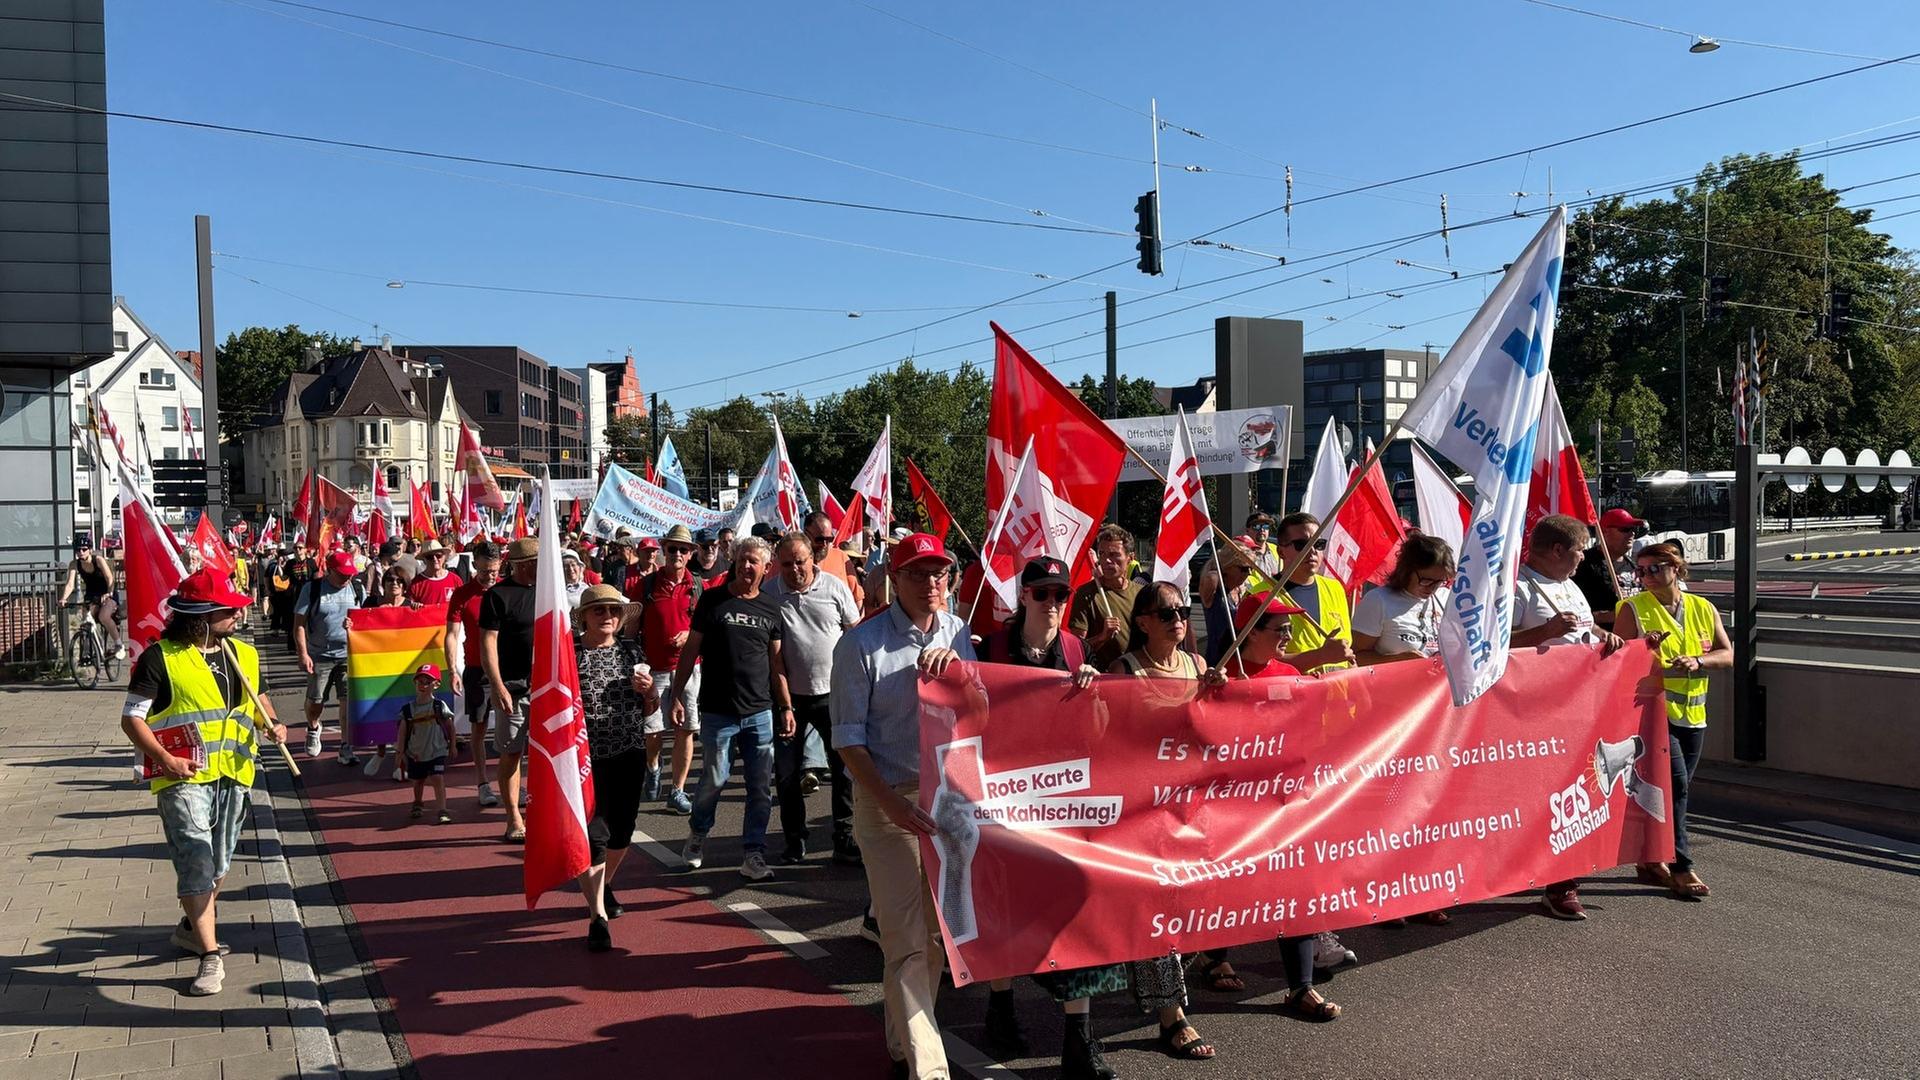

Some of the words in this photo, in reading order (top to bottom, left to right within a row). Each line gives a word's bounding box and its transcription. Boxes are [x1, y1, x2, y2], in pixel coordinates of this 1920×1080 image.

[1198, 439, 1212, 448] mit
[1199, 452, 1236, 464] fbindung!
[628, 478, 680, 508] ORGANISIERE
[648, 499, 698, 527] FASCHISMUS,
[1157, 737, 1188, 761] Es
[1202, 733, 1286, 762] reicht!
[986, 777, 1028, 800] Rote
[1032, 767, 1084, 791] Karte
[1152, 785, 1197, 806] Wir
[1204, 773, 1306, 802] kämpfen
[1312, 764, 1348, 789] für
[1359, 753, 1440, 780] unseren
[1449, 735, 1567, 768] Sozialstaat:
[973, 806, 1004, 820] dem
[1006, 803, 1117, 825] Kahlschlag!
[1549, 774, 1591, 832] SOS
[1152, 856, 1257, 886] Schluss
[1268, 843, 1305, 872] mit
[1314, 807, 1523, 864] Verschlechterungen!
[1150, 897, 1298, 938] Solidarität
[1306, 887, 1358, 916] statt
[1366, 863, 1466, 907] Spaltung!
